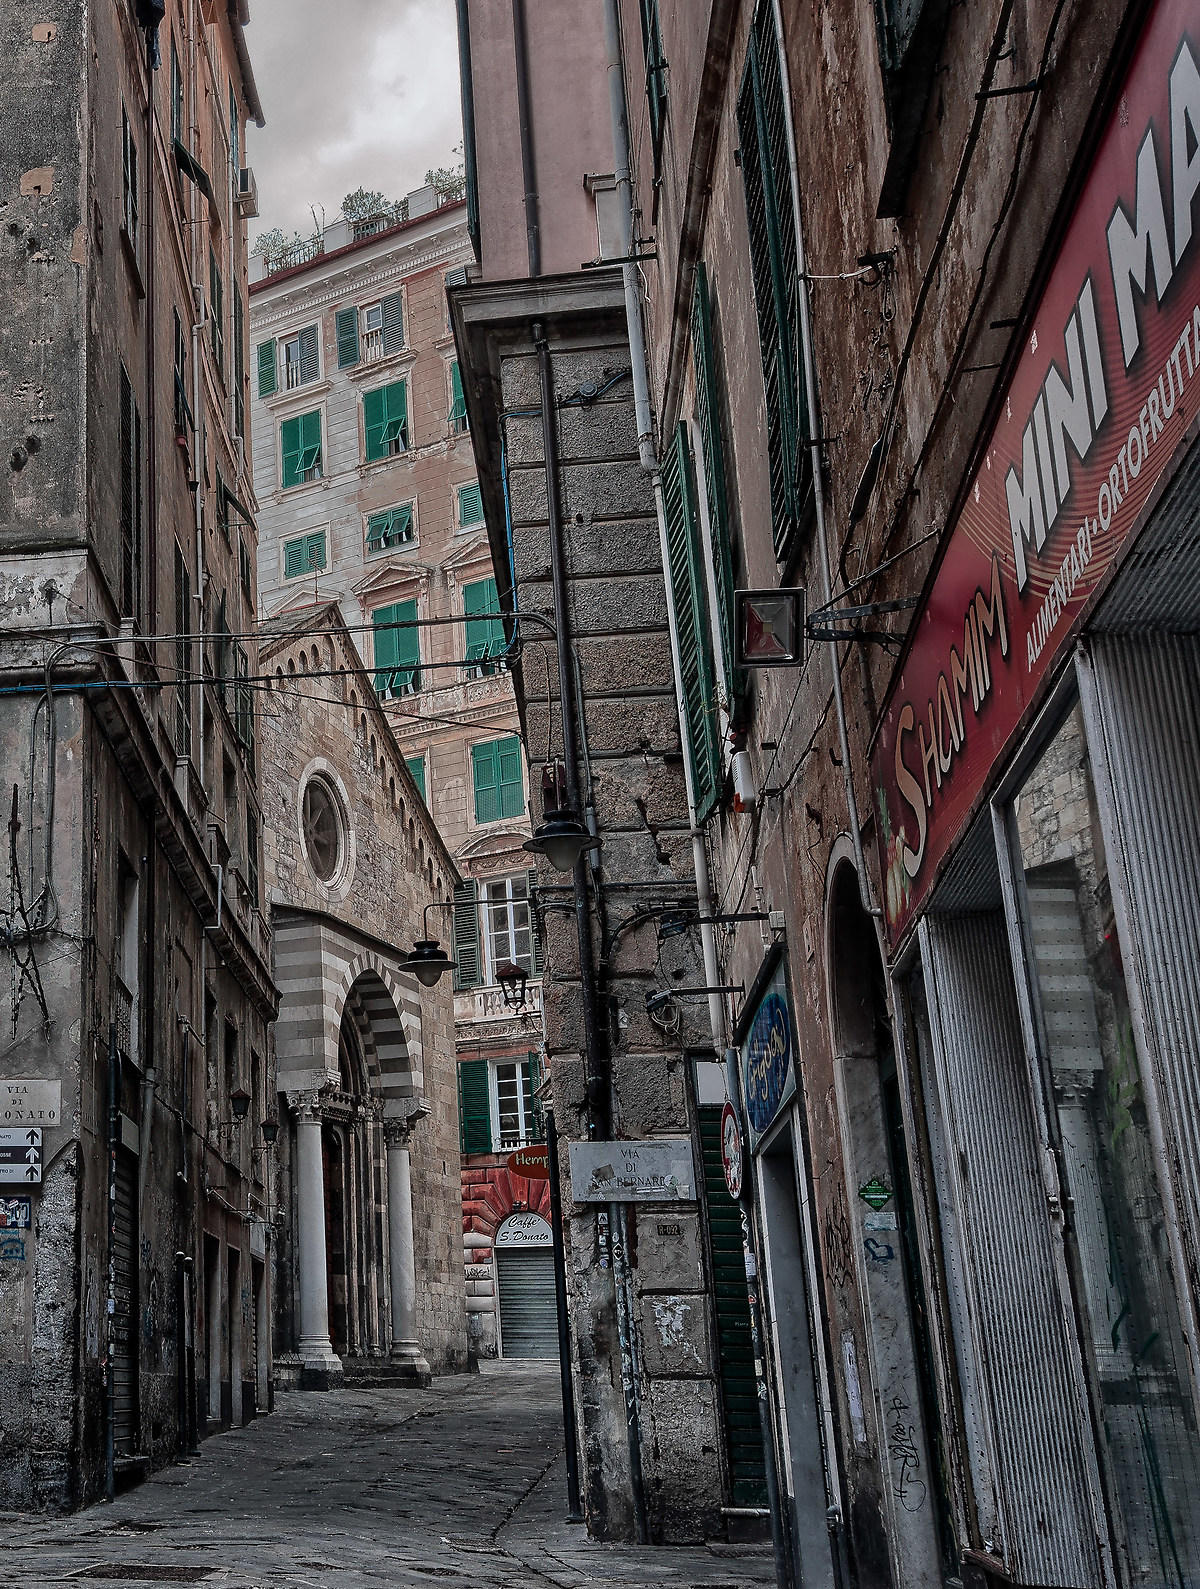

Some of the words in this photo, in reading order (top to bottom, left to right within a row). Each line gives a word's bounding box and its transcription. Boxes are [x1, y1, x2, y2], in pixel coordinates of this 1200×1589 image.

[1005, 278, 1108, 594] MINI
[1026, 516, 1093, 672] ALIMENTARI
[7, 1086, 28, 1094] VIA
[621, 1149, 640, 1159] VIA
[625, 1163, 637, 1172] DI
